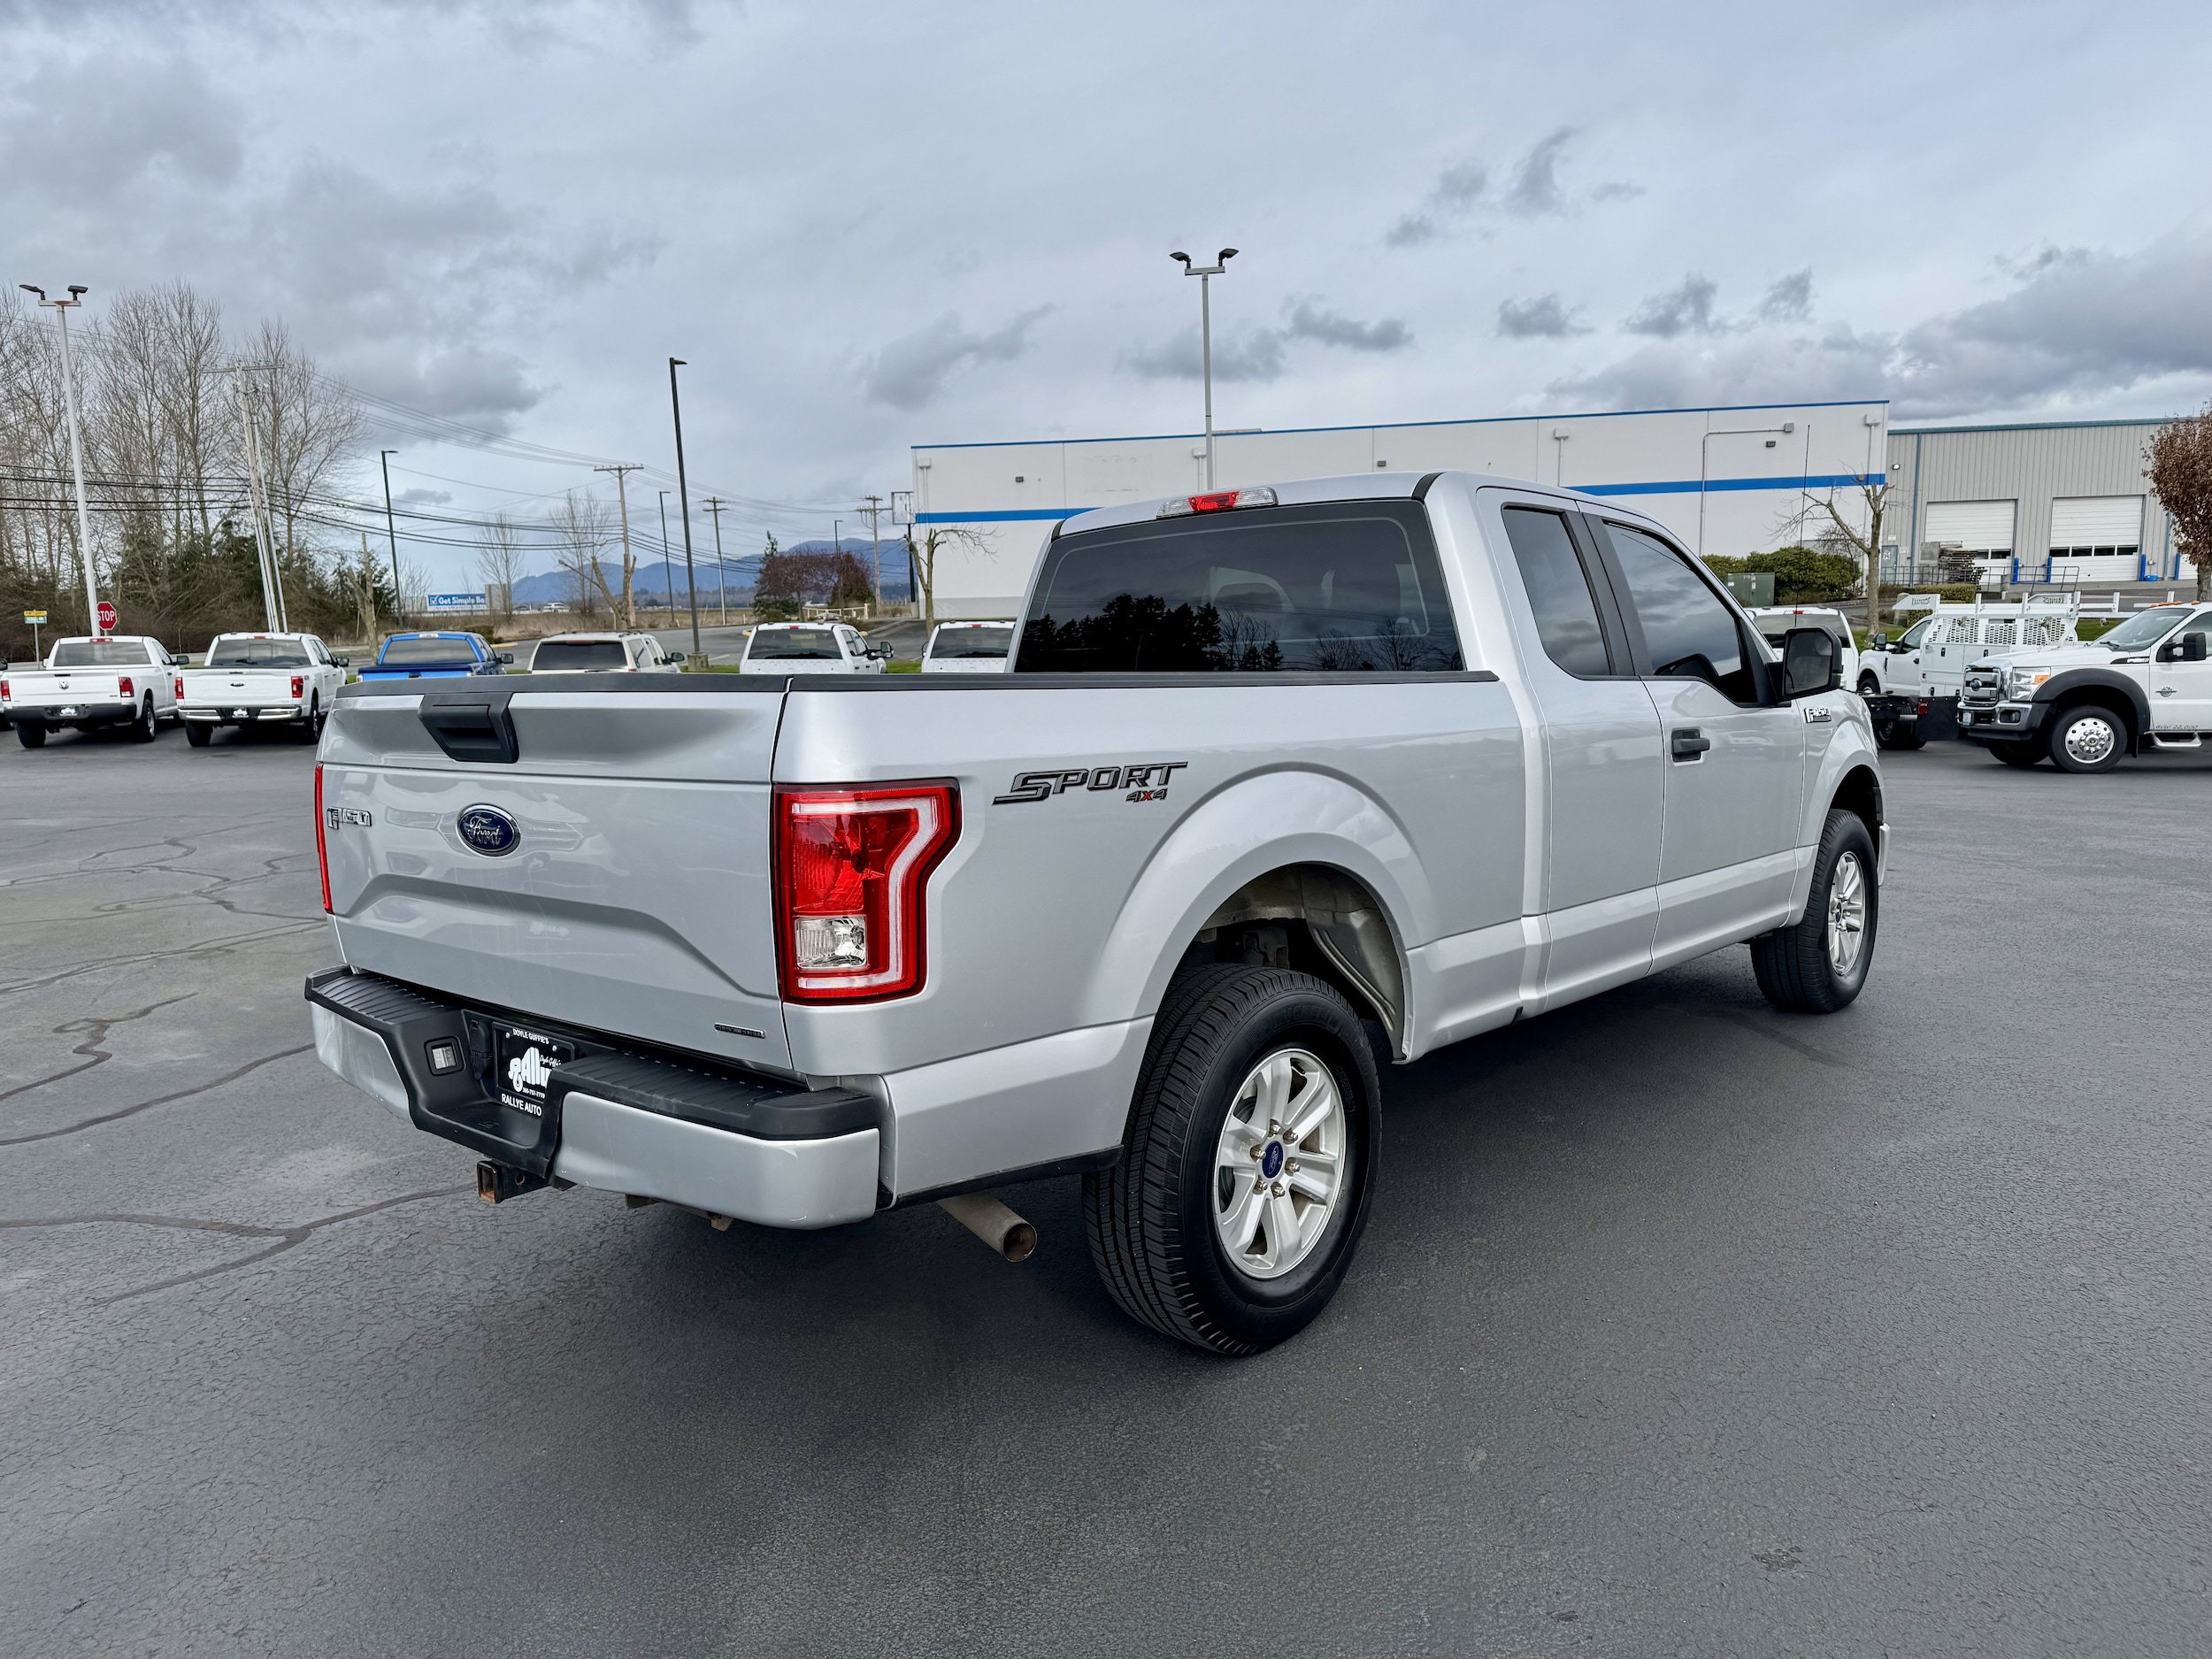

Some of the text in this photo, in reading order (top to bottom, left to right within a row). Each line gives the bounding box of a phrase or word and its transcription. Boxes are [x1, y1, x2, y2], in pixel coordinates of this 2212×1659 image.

[452, 596, 475, 605] Simple
[97, 611, 115, 621] STOP
[991, 761, 1188, 806] SPORT
[466, 815, 502, 845] Ford
[512, 1027, 528, 1040] DOYLE
[501, 1093, 542, 1117] RALLYE AUTO
